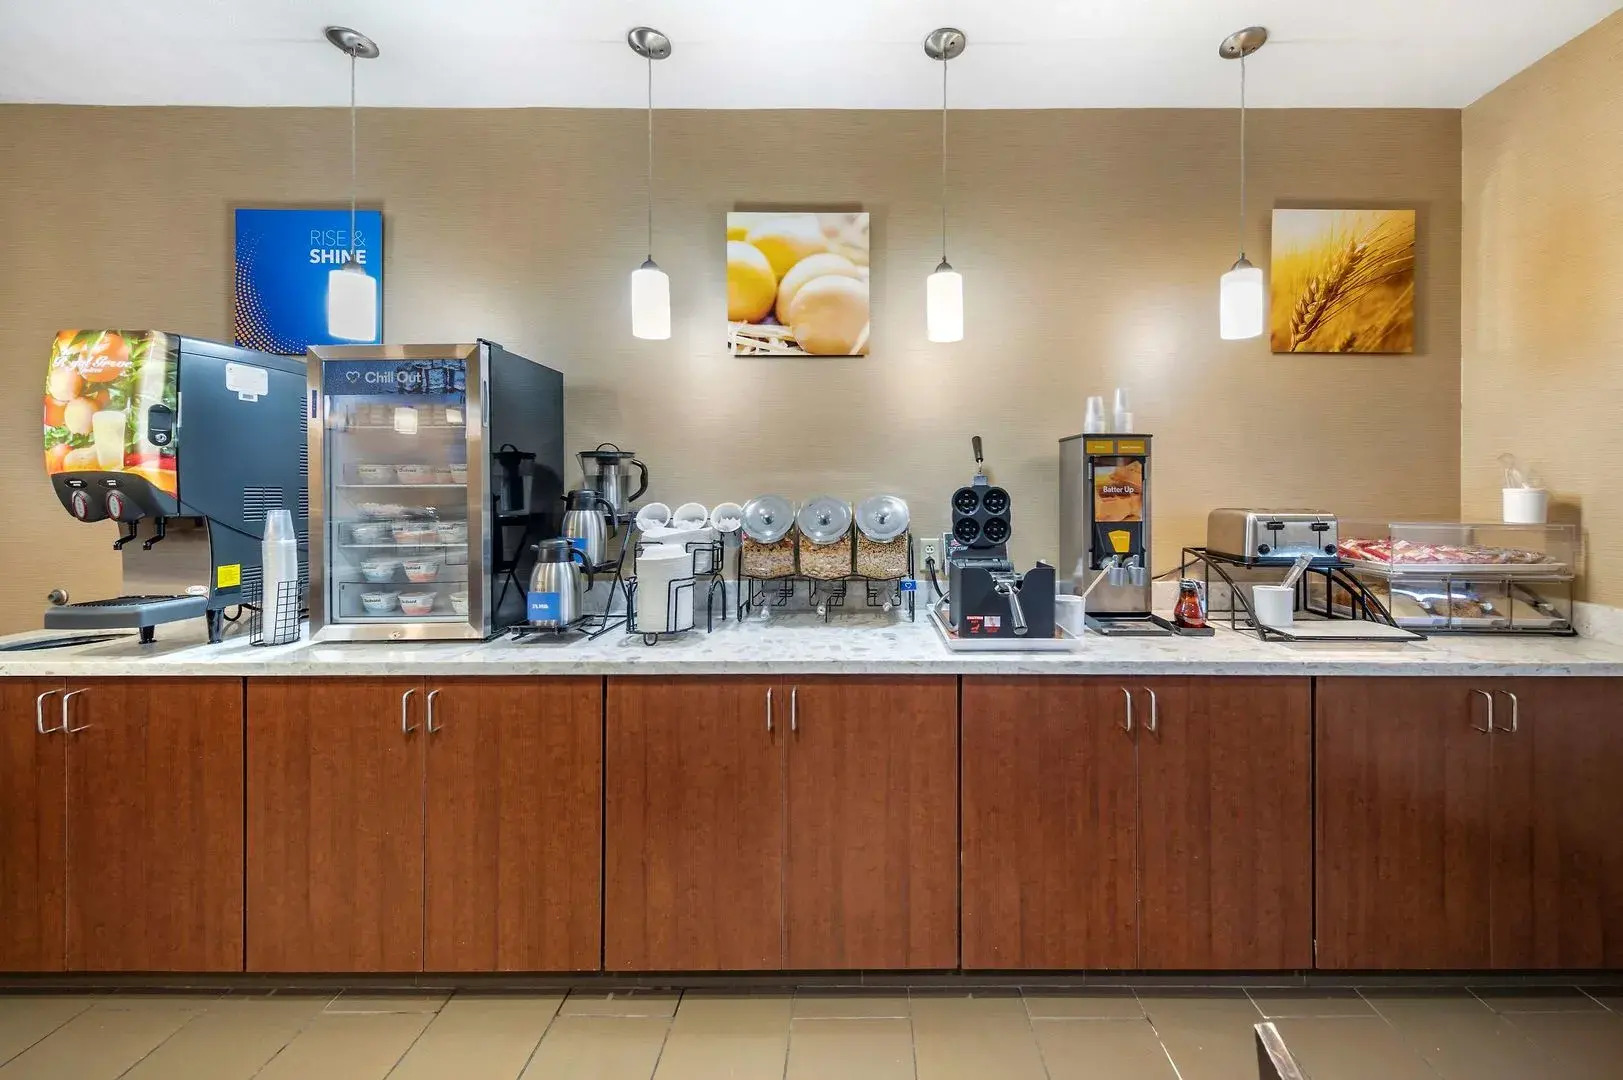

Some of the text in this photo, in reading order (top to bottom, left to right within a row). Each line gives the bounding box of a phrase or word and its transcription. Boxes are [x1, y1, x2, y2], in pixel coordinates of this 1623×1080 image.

[310, 230, 366, 247] RISE &
[309, 248, 367, 264] SHINE
[364, 370, 422, 384] Chill Out
[1103, 485, 1134, 493] Batter Up
